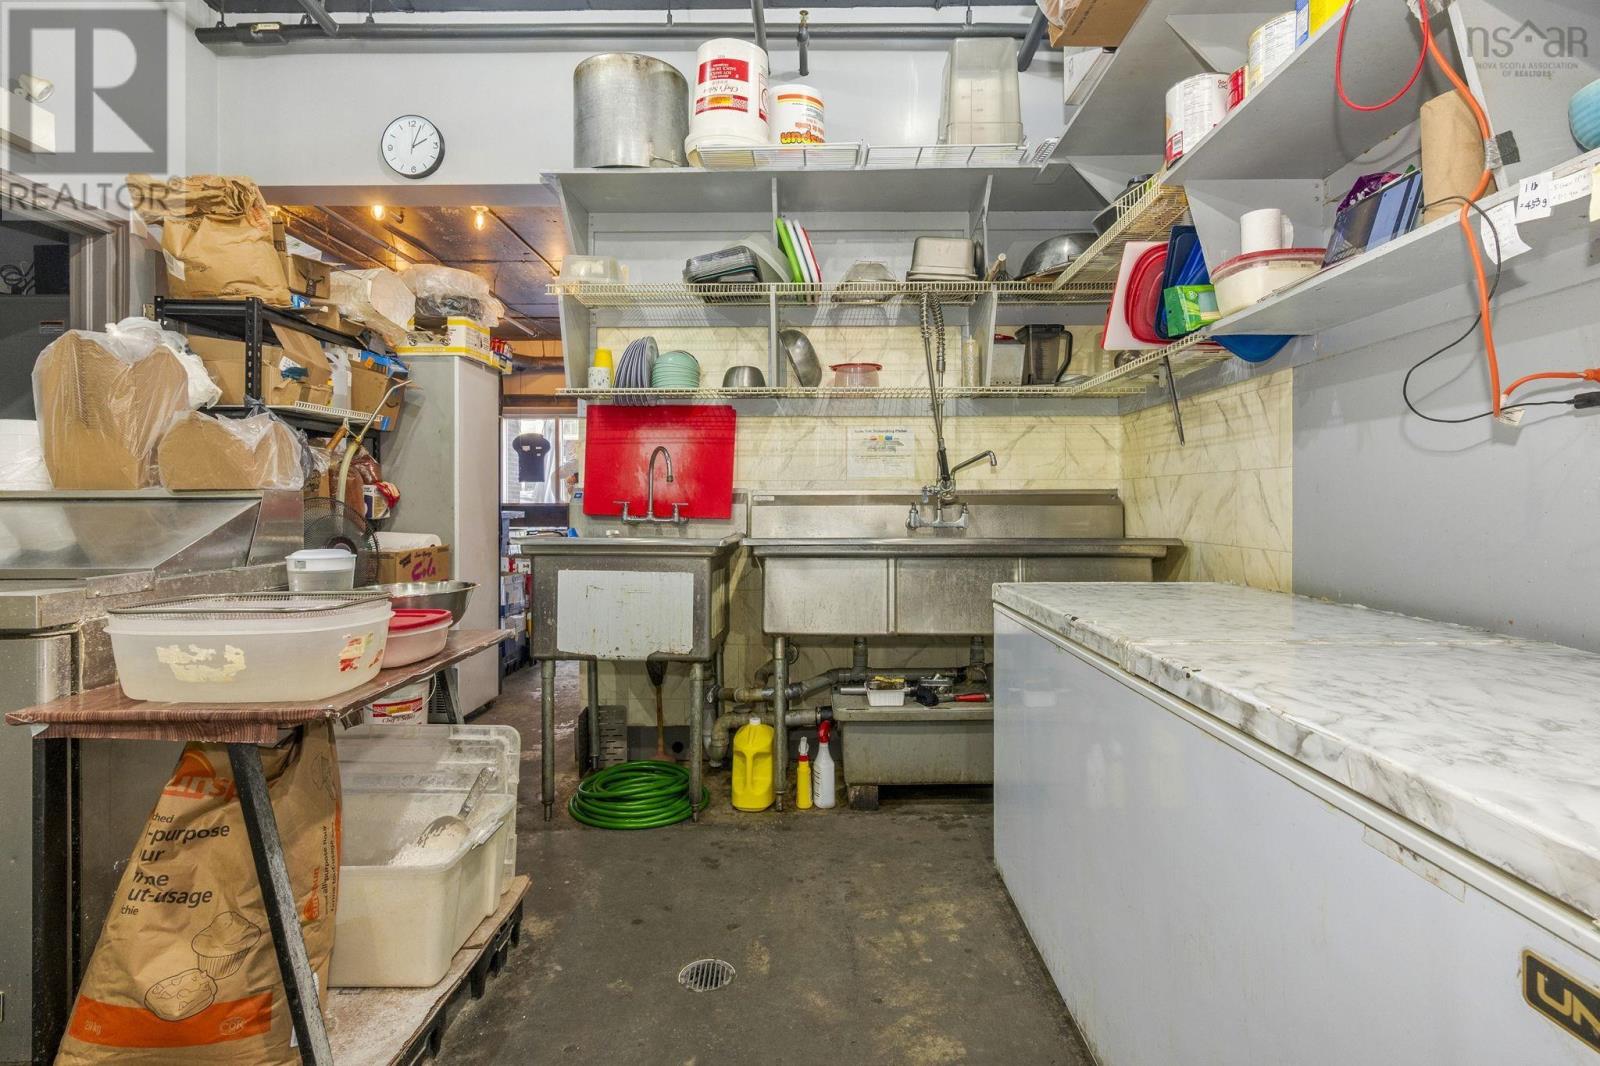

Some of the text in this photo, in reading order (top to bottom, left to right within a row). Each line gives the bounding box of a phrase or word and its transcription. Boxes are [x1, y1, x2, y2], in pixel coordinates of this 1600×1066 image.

[408, 120, 417, 128] 12
[387, 144, 394, 152] 9
[433, 142, 439, 150] 3
[411, 165, 417, 173] 6
[146, 824, 231, 844] -purpose
[140, 849, 165, 862] ur
